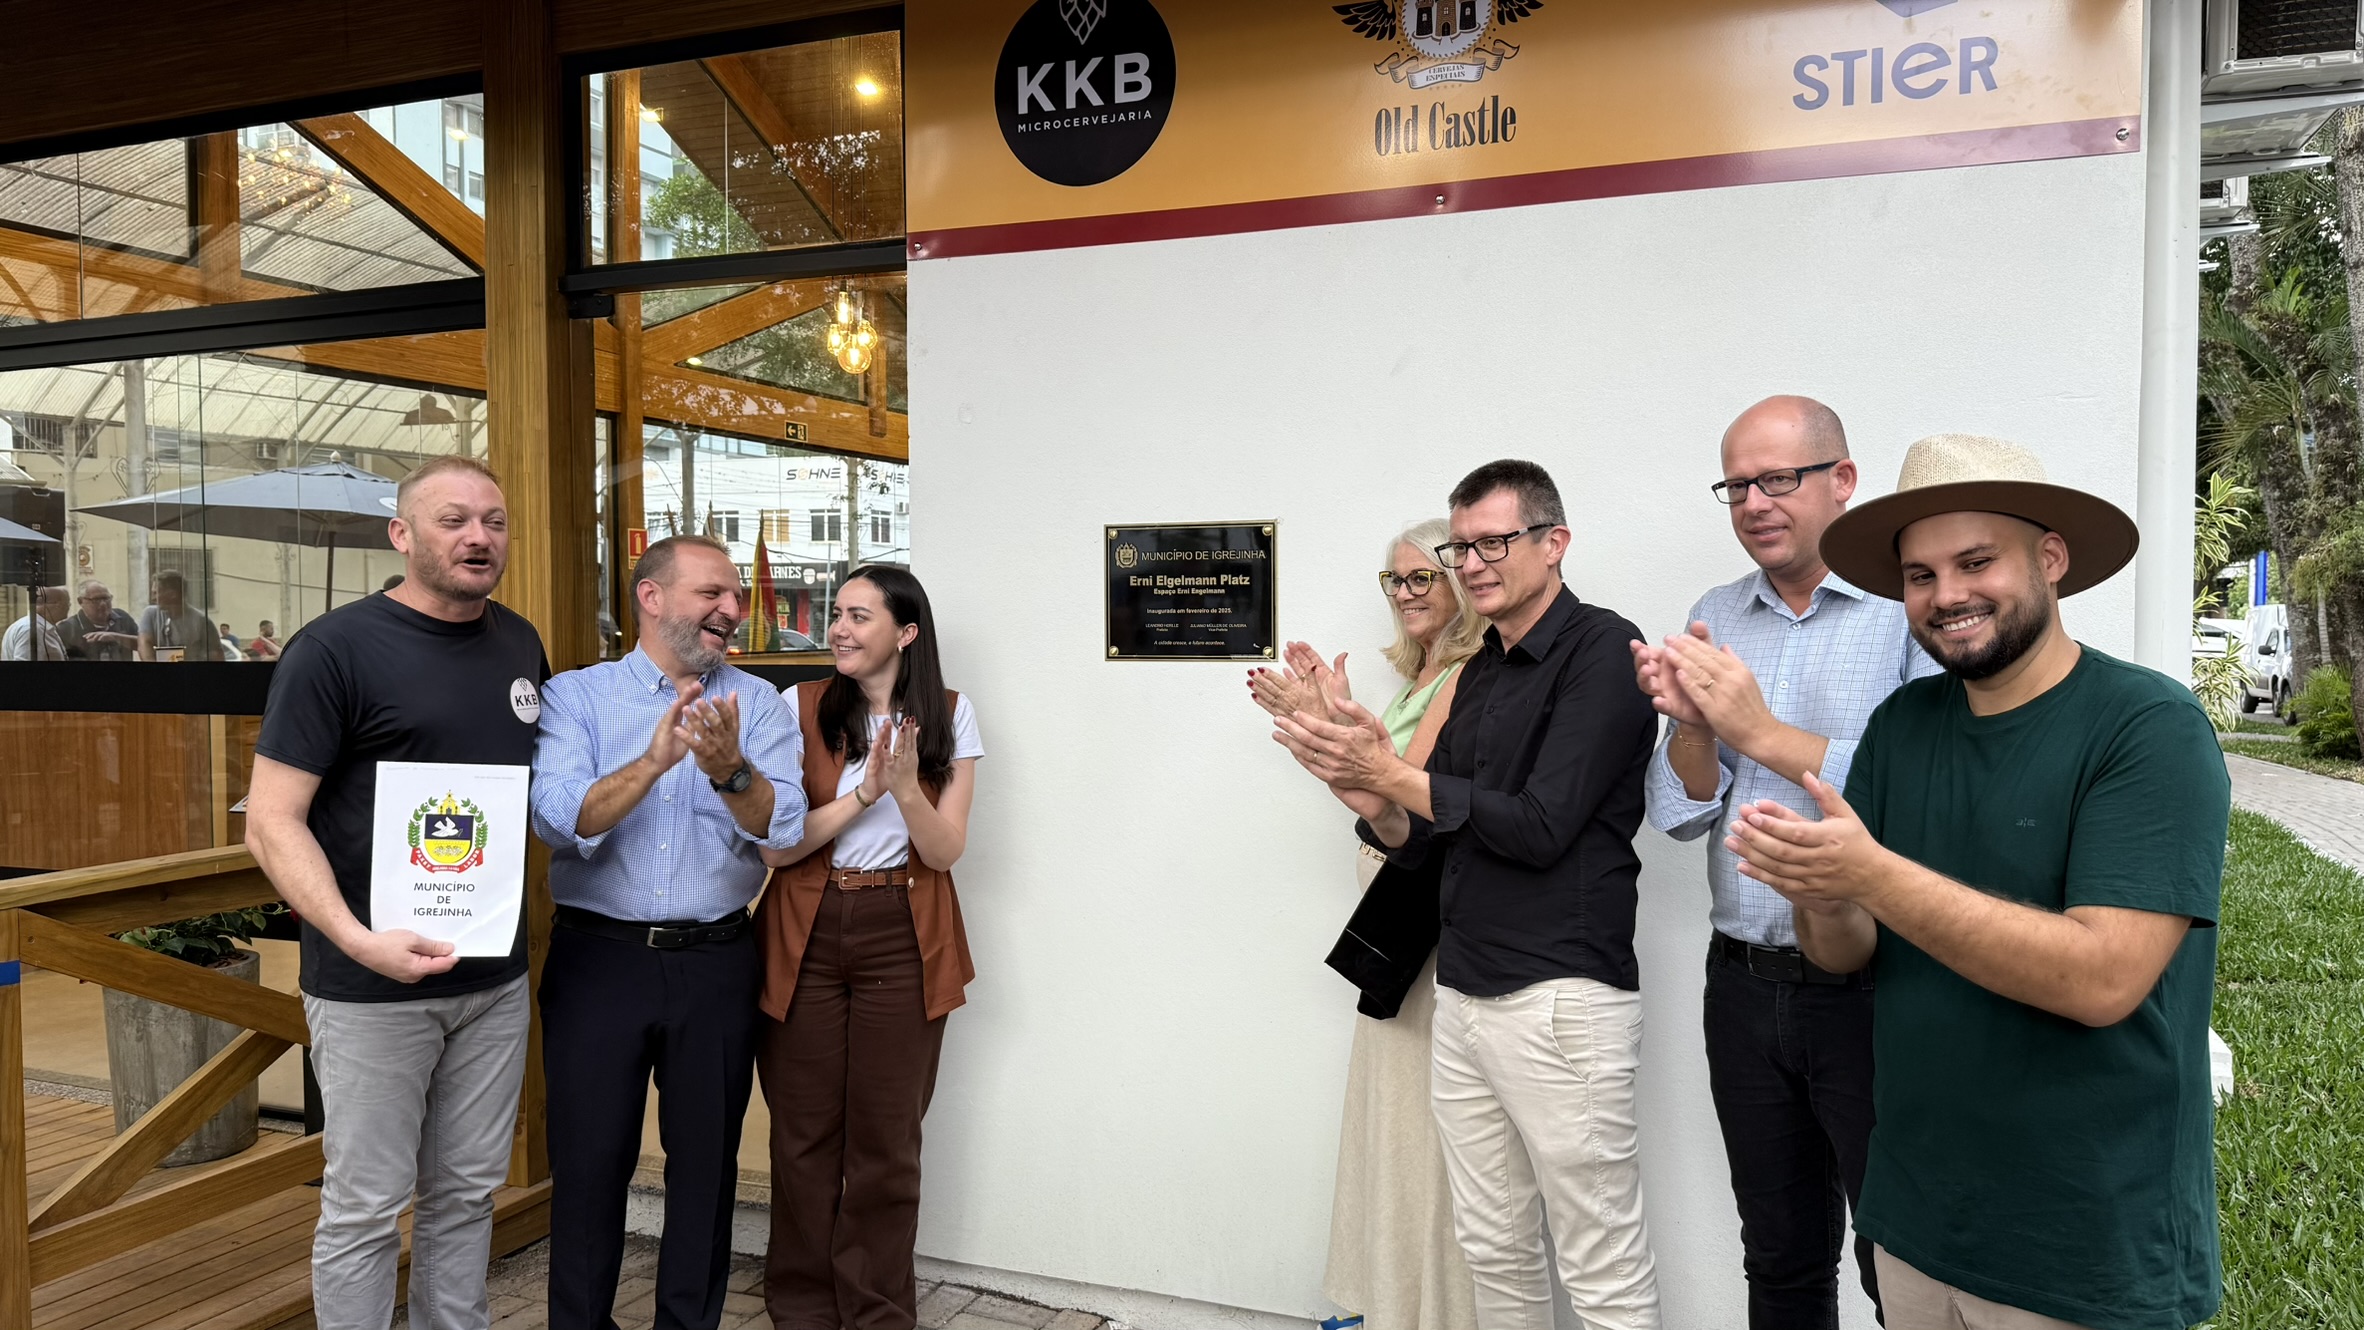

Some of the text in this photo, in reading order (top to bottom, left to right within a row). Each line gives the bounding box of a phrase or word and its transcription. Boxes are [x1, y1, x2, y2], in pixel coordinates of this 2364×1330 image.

[1428, 64, 1465, 74] CERVEJAS
[1425, 70, 1466, 82] ESPECIAIS
[1017, 51, 1152, 115] KKB
[1017, 110, 1152, 133] MICROCERVEJARIA
[1374, 95, 1517, 157] Old Castle
[1141, 548, 1266, 561] MUNICÍPIO DE IGREJINHA
[1129, 575, 1153, 587] Erni
[1220, 574, 1250, 586] Platz
[514, 694, 538, 707] KKB
[413, 881, 475, 892] MUNICÍPIO
[436, 895, 451, 904] DE
[413, 907, 473, 917] IGREJINHA
